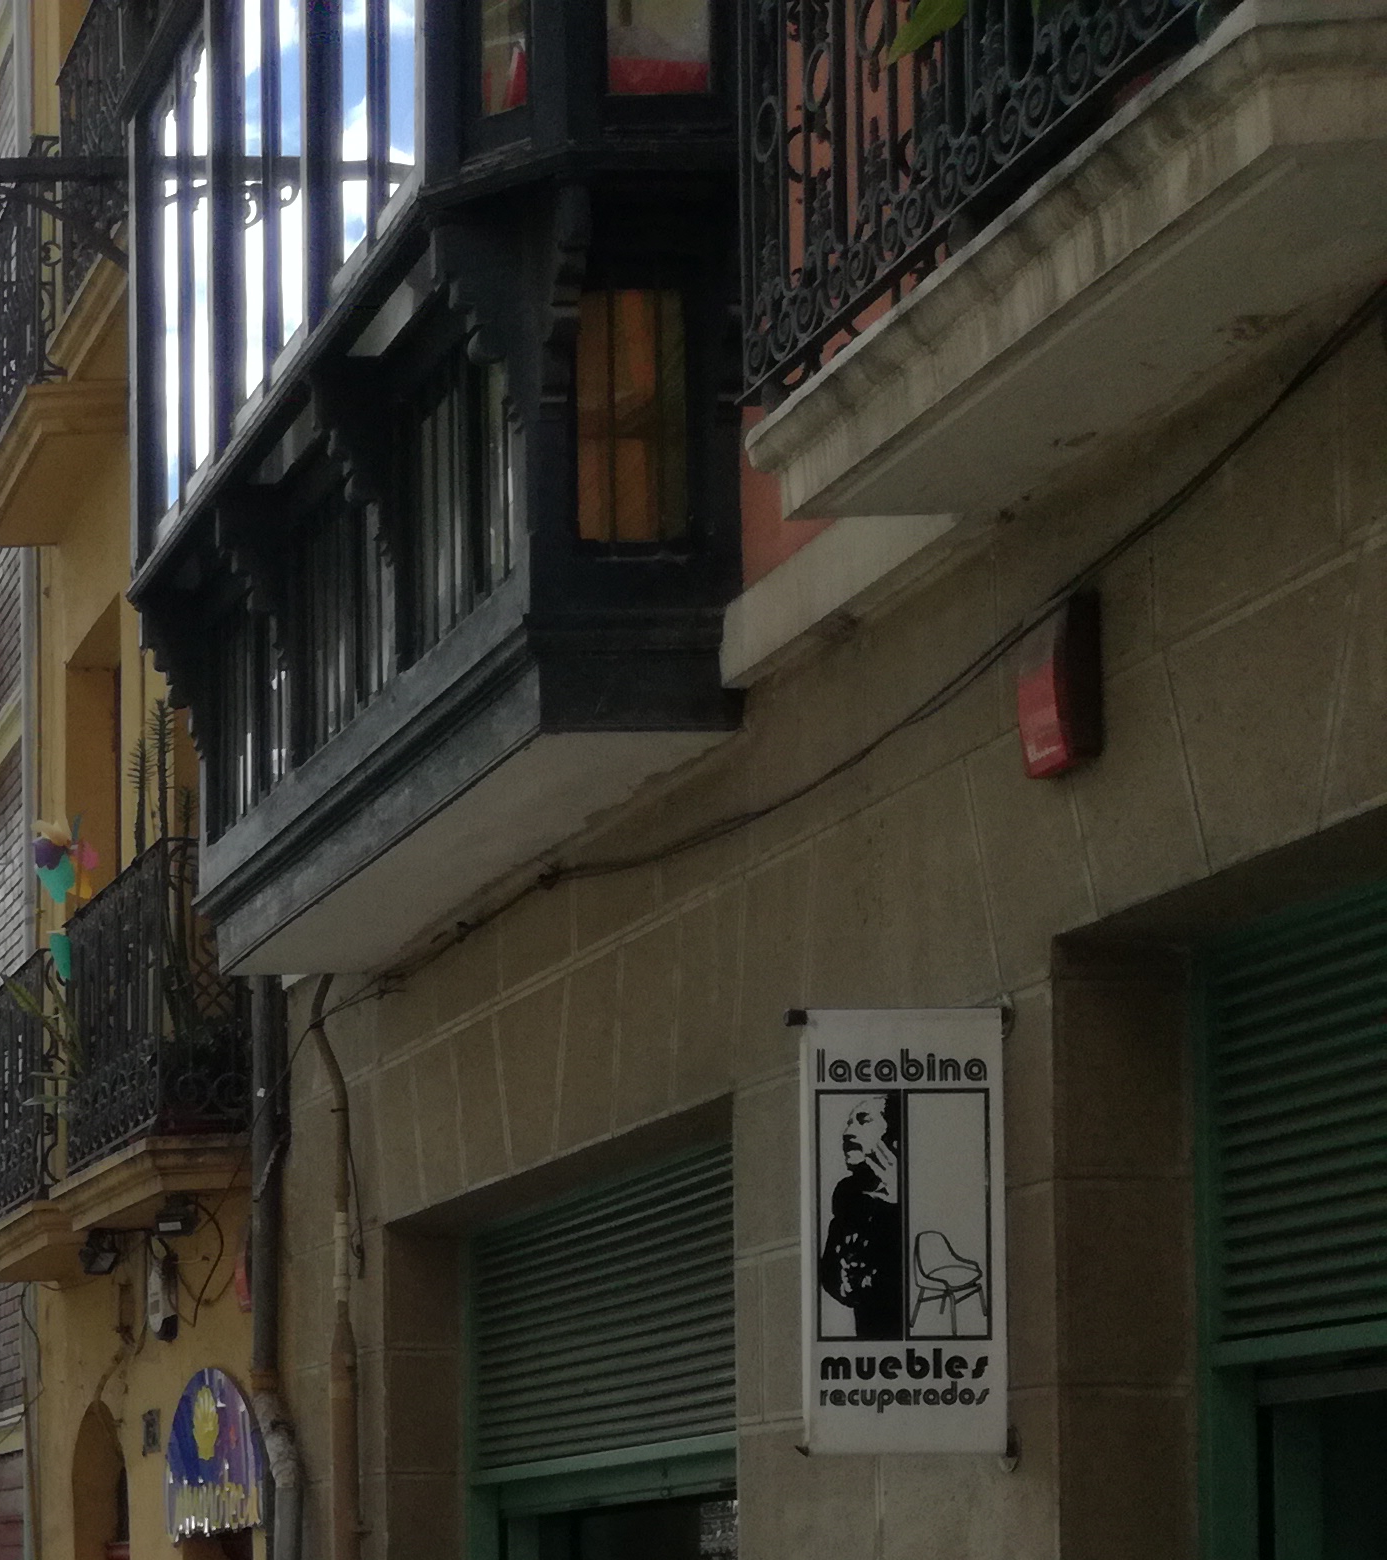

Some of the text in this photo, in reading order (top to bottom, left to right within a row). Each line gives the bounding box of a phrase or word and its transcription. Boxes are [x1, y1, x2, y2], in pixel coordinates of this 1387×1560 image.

[815, 1048, 989, 1083] lacabina
[820, 1348, 990, 1380] muebles
[819, 1381, 990, 1414] recuperados
